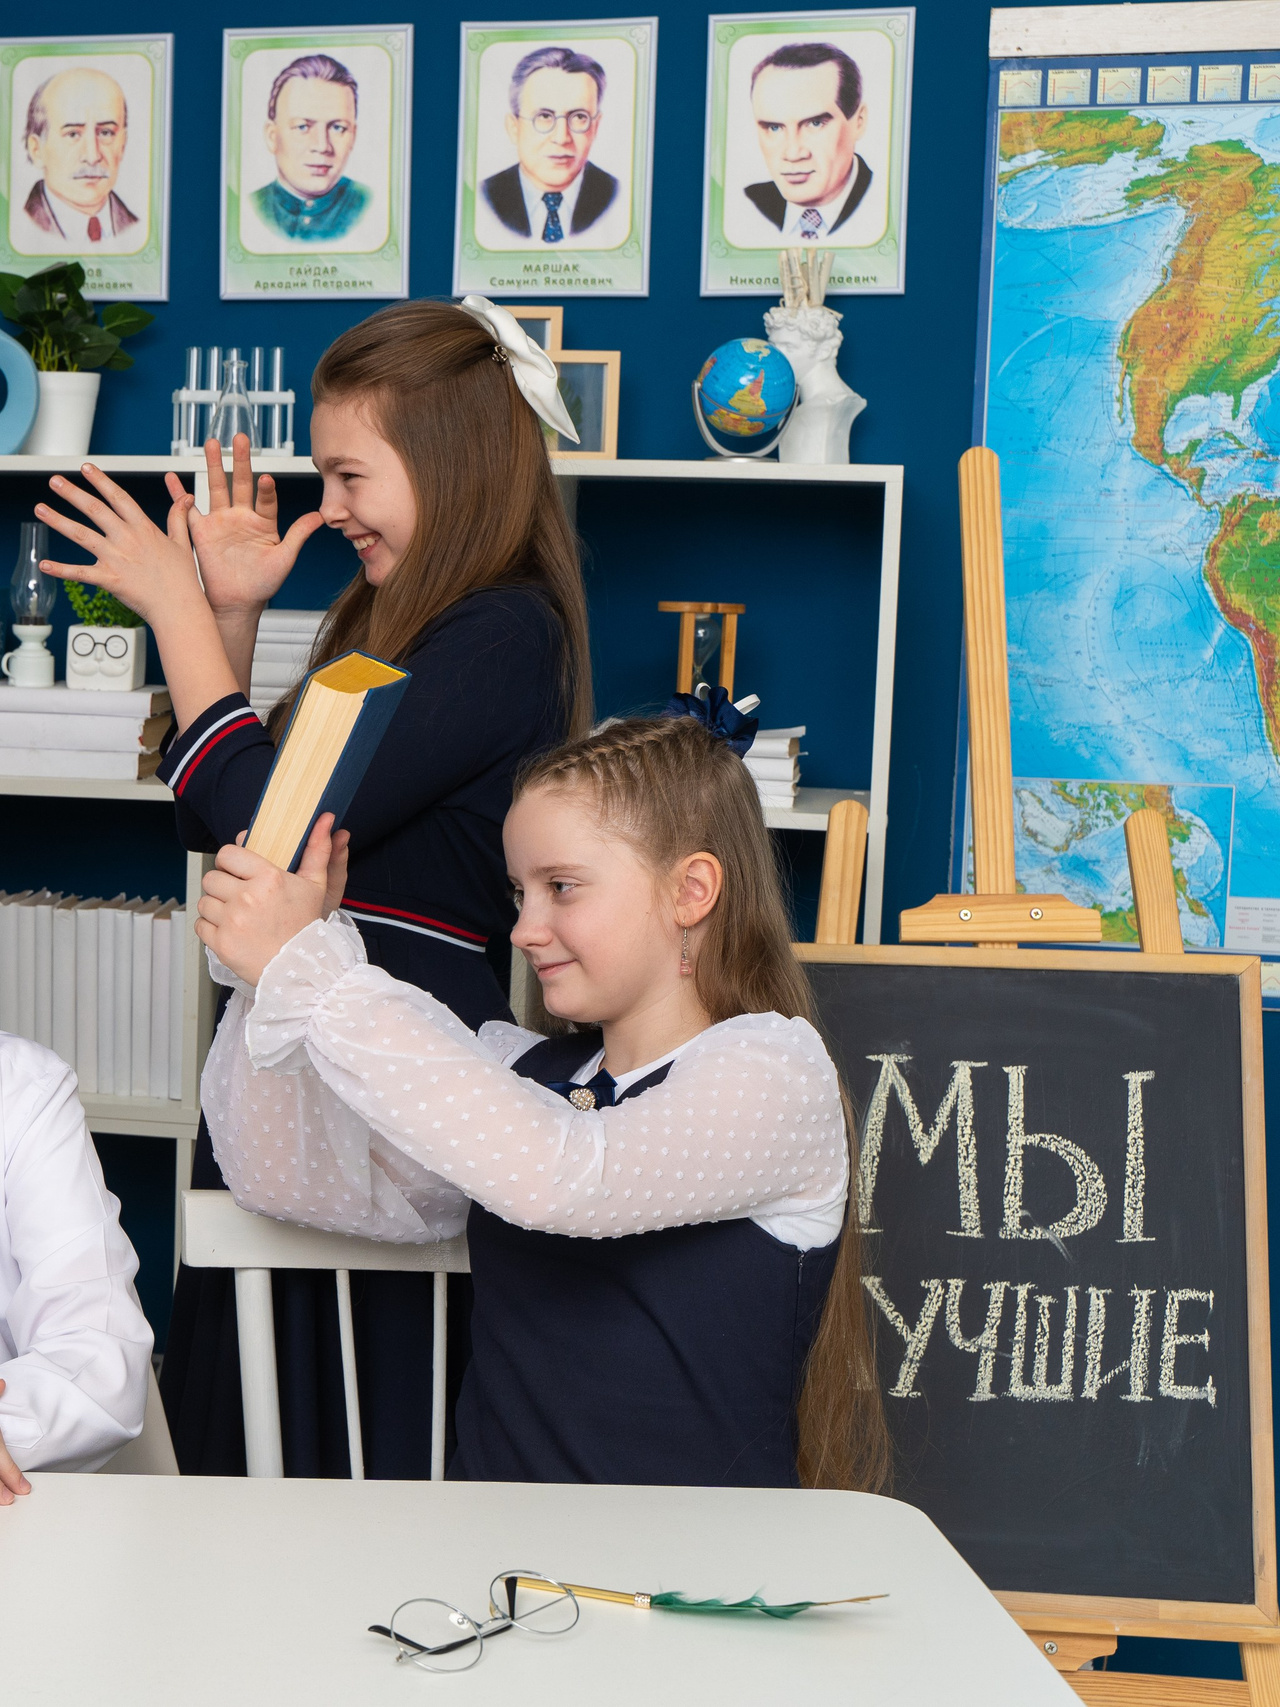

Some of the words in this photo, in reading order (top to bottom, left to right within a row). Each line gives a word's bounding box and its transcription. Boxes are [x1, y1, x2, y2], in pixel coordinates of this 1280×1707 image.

[289, 264, 338, 276] ГАЙДАР
[522, 263, 580, 273] МАРШАК
[82, 281, 133, 290] панович
[254, 279, 307, 290] Аркадий
[313, 278, 373, 289] Петрович
[489, 276, 537, 289] Самуил
[544, 276, 613, 287] Яковлевич
[729, 275, 779, 285] Никола
[828, 275, 877, 285] лаевич
[855, 1053, 1156, 1243] МЫ
[859, 1275, 1217, 1408] УЧШИЕ
